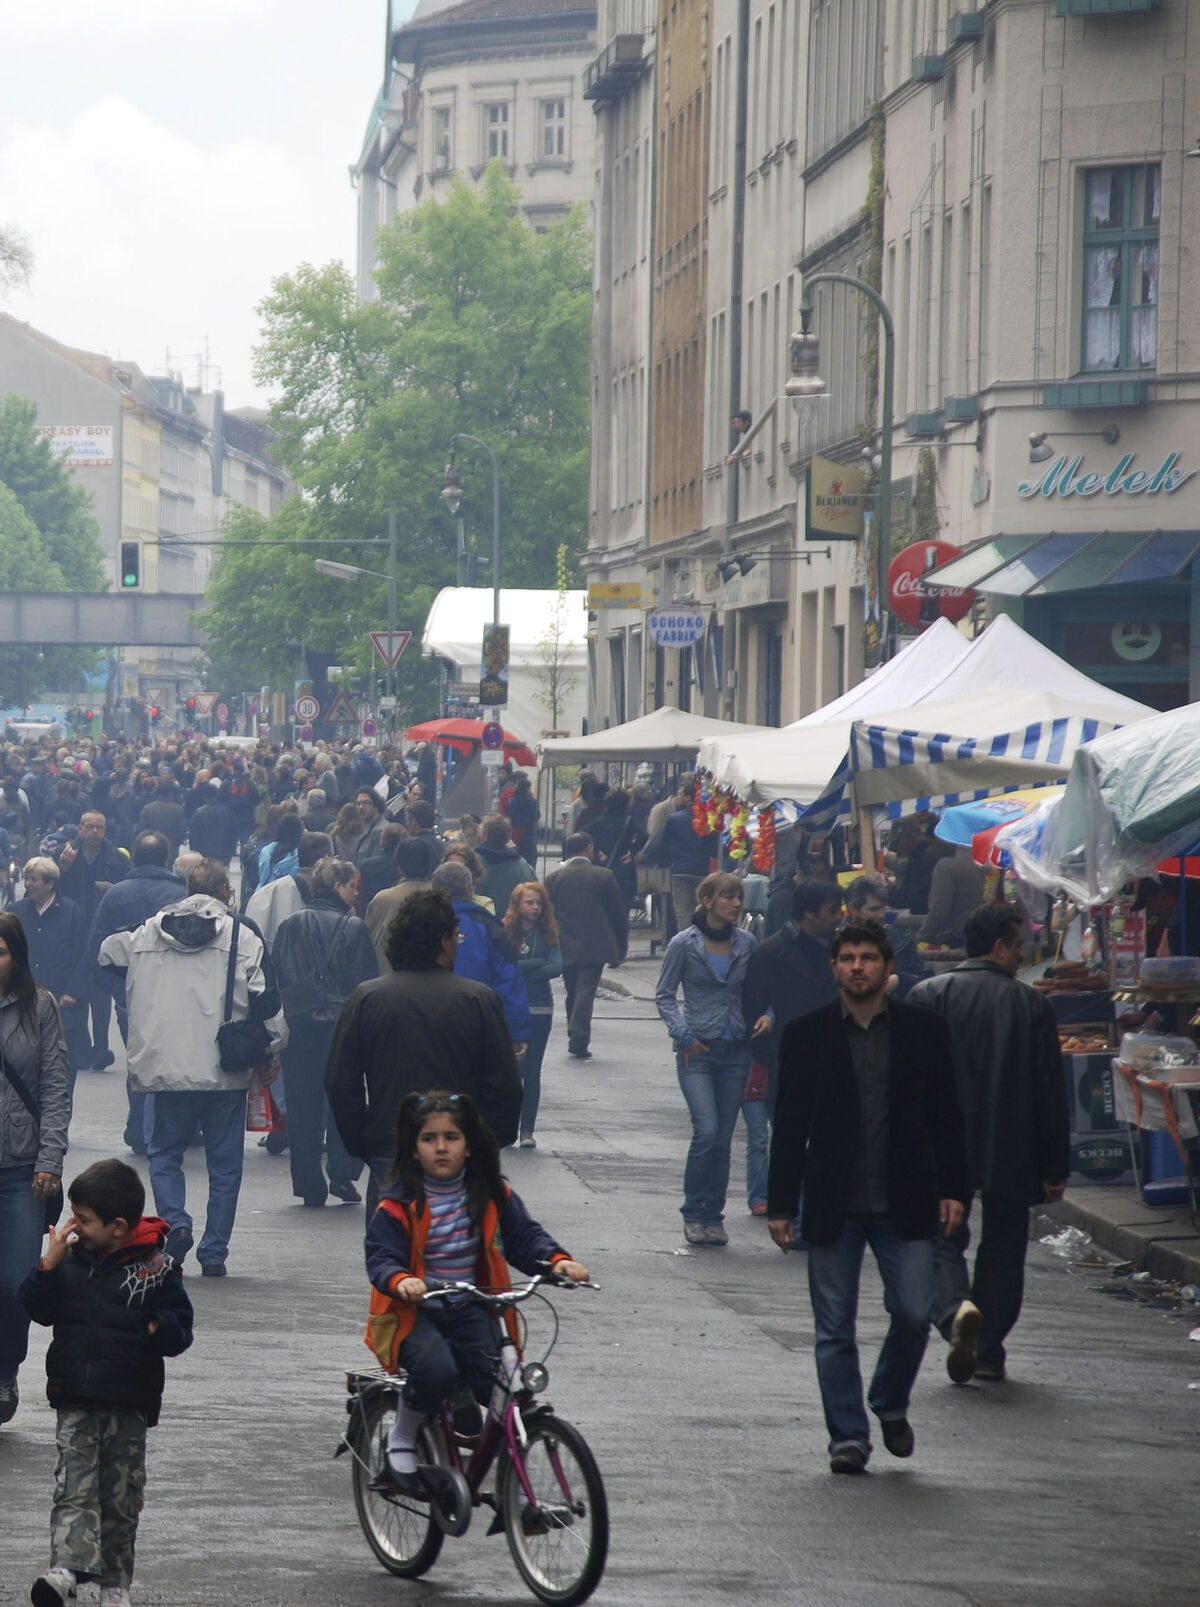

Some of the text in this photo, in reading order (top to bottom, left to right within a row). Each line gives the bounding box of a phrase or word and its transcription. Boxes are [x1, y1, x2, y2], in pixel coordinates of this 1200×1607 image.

[87, 427, 111, 436] BOY
[1018, 451, 1198, 498] Melek
[651, 616, 704, 629] SCHOKO
[656, 629, 697, 642] FABRIK
[302, 703, 313, 715] 30
